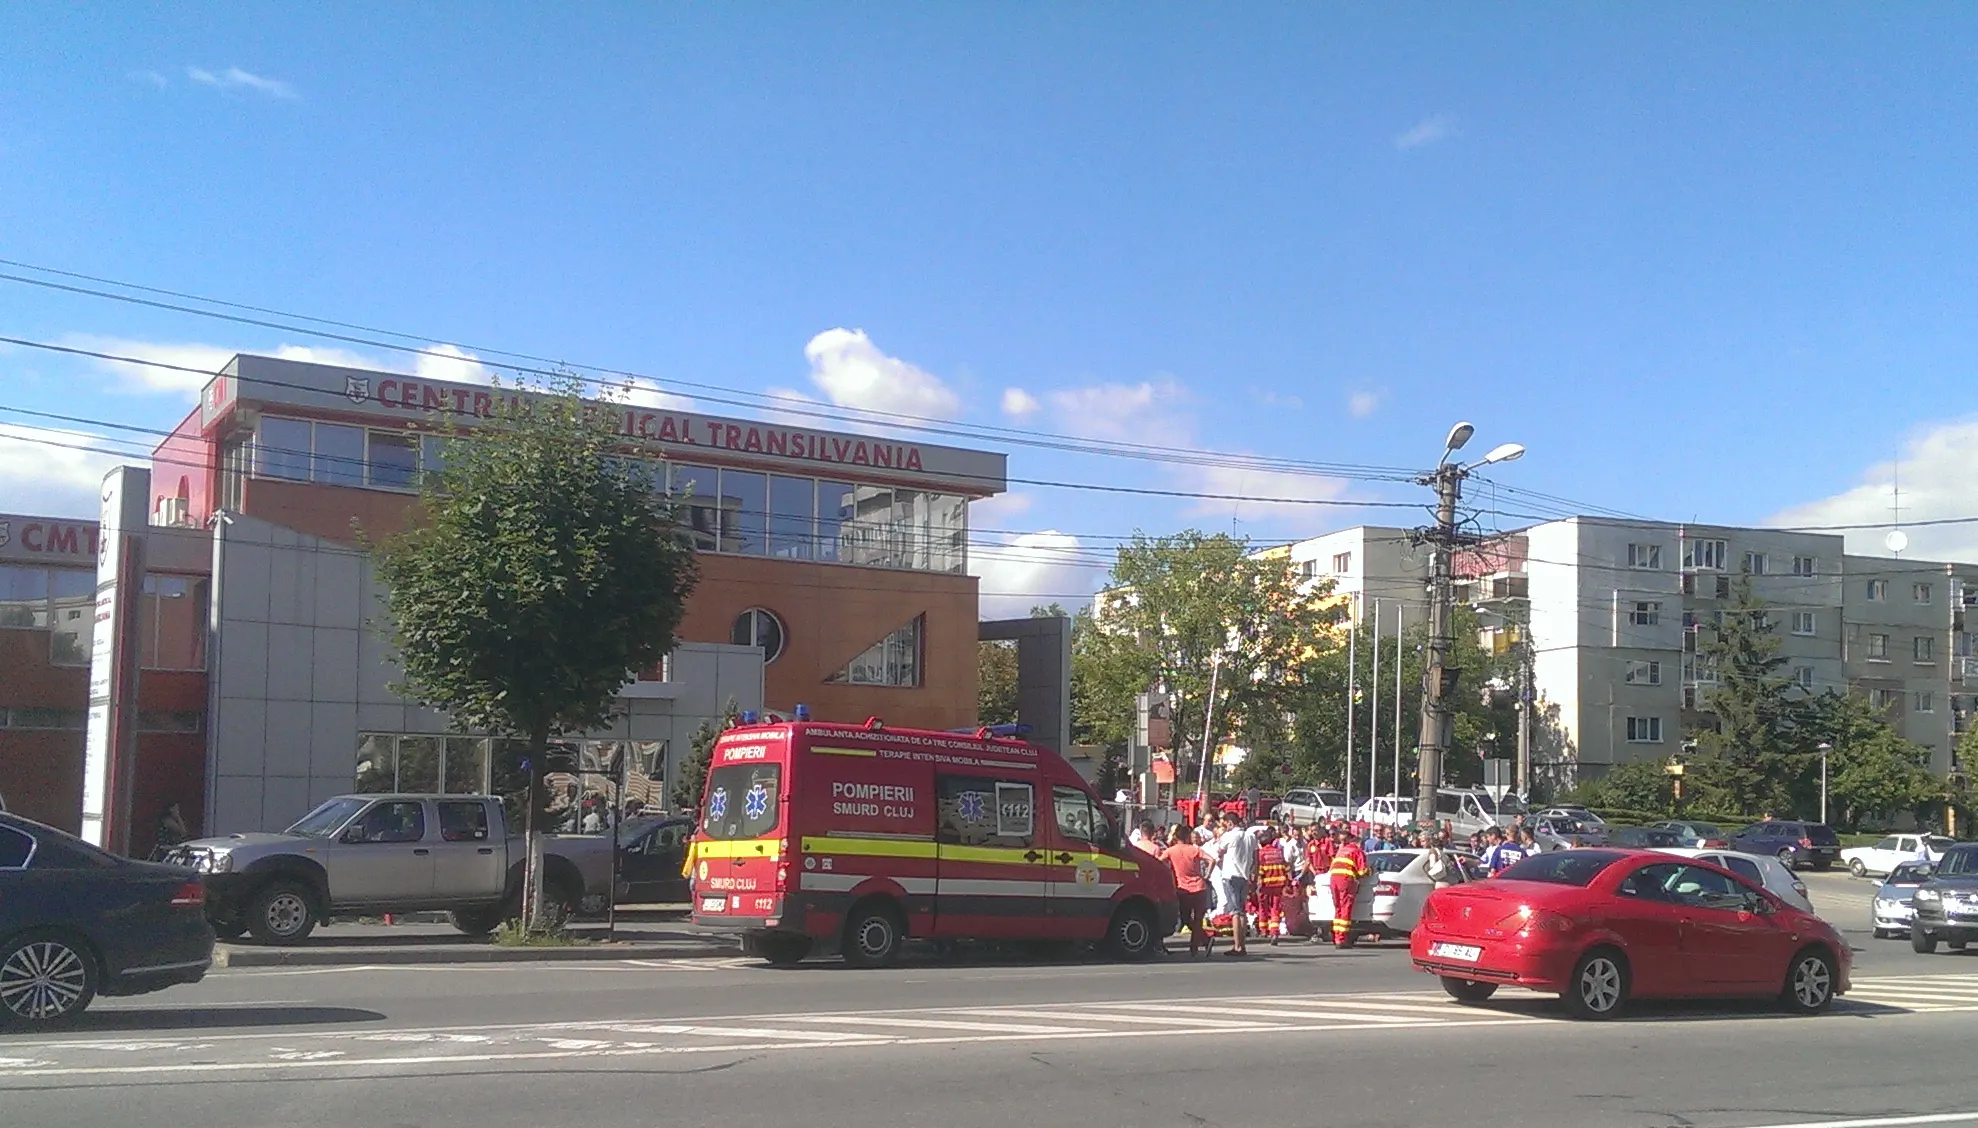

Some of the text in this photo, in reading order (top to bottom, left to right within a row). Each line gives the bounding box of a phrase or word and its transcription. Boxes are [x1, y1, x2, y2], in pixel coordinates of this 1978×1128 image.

[706, 421, 923, 471] TRANSILVANIA
[21, 523, 100, 555] CMT
[911, 737, 921, 745] DE
[723, 745, 767, 762] POMPIERII
[879, 750, 911, 760] TERAPIE
[832, 782, 914, 802] POMPIERII
[833, 801, 914, 819] SMURD CLUJ
[710, 877, 757, 890] SMURD CLUJ
